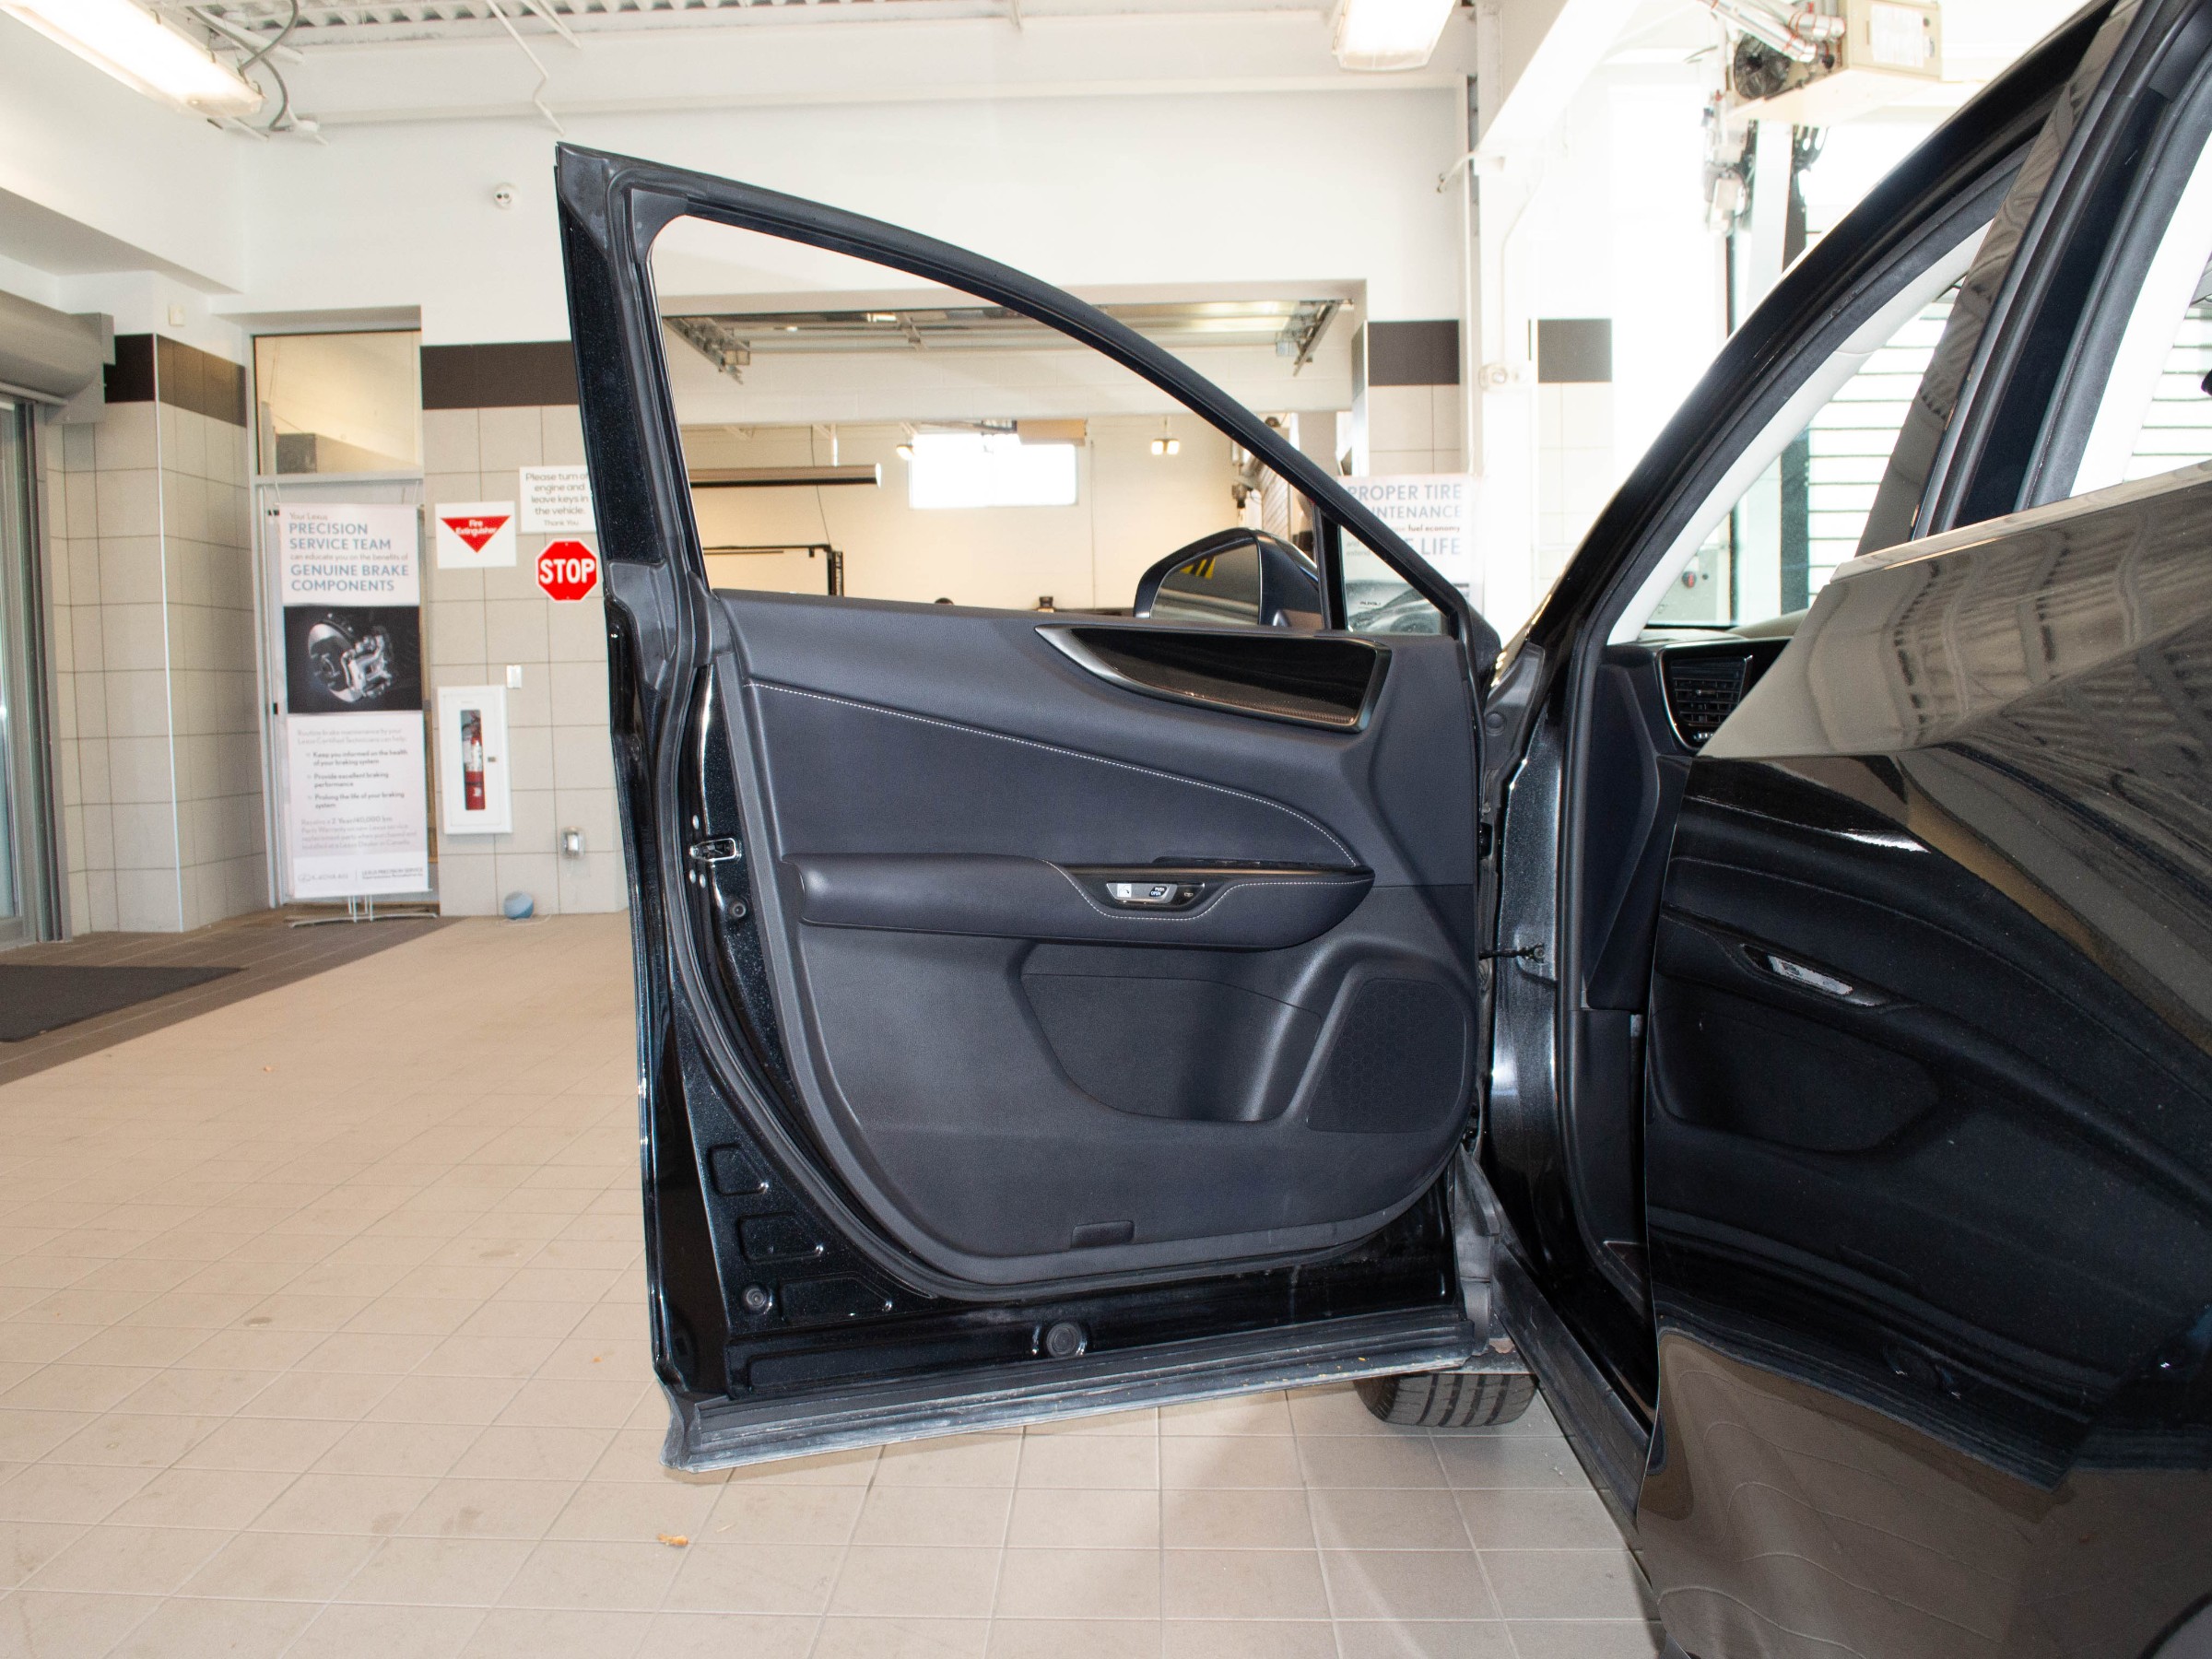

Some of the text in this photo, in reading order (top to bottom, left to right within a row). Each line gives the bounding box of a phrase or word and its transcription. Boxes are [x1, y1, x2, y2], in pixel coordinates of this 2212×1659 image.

[535, 483, 584, 494] engine and
[1347, 484, 1461, 500] PROPER TIRE
[558, 495, 578, 504] keys
[535, 507, 550, 515] the
[1371, 505, 1461, 519] INTENANCE
[288, 523, 368, 535] PRECISION
[469, 519, 483, 527] Fire
[455, 527, 498, 537] Extinguisher
[289, 538, 391, 550] SERVICE TEAM
[1421, 537, 1461, 555] LIFE
[290, 564, 409, 576] GENUINE BRAKE
[539, 559, 595, 583] STOP
[291, 580, 394, 591] COMPONENTS
